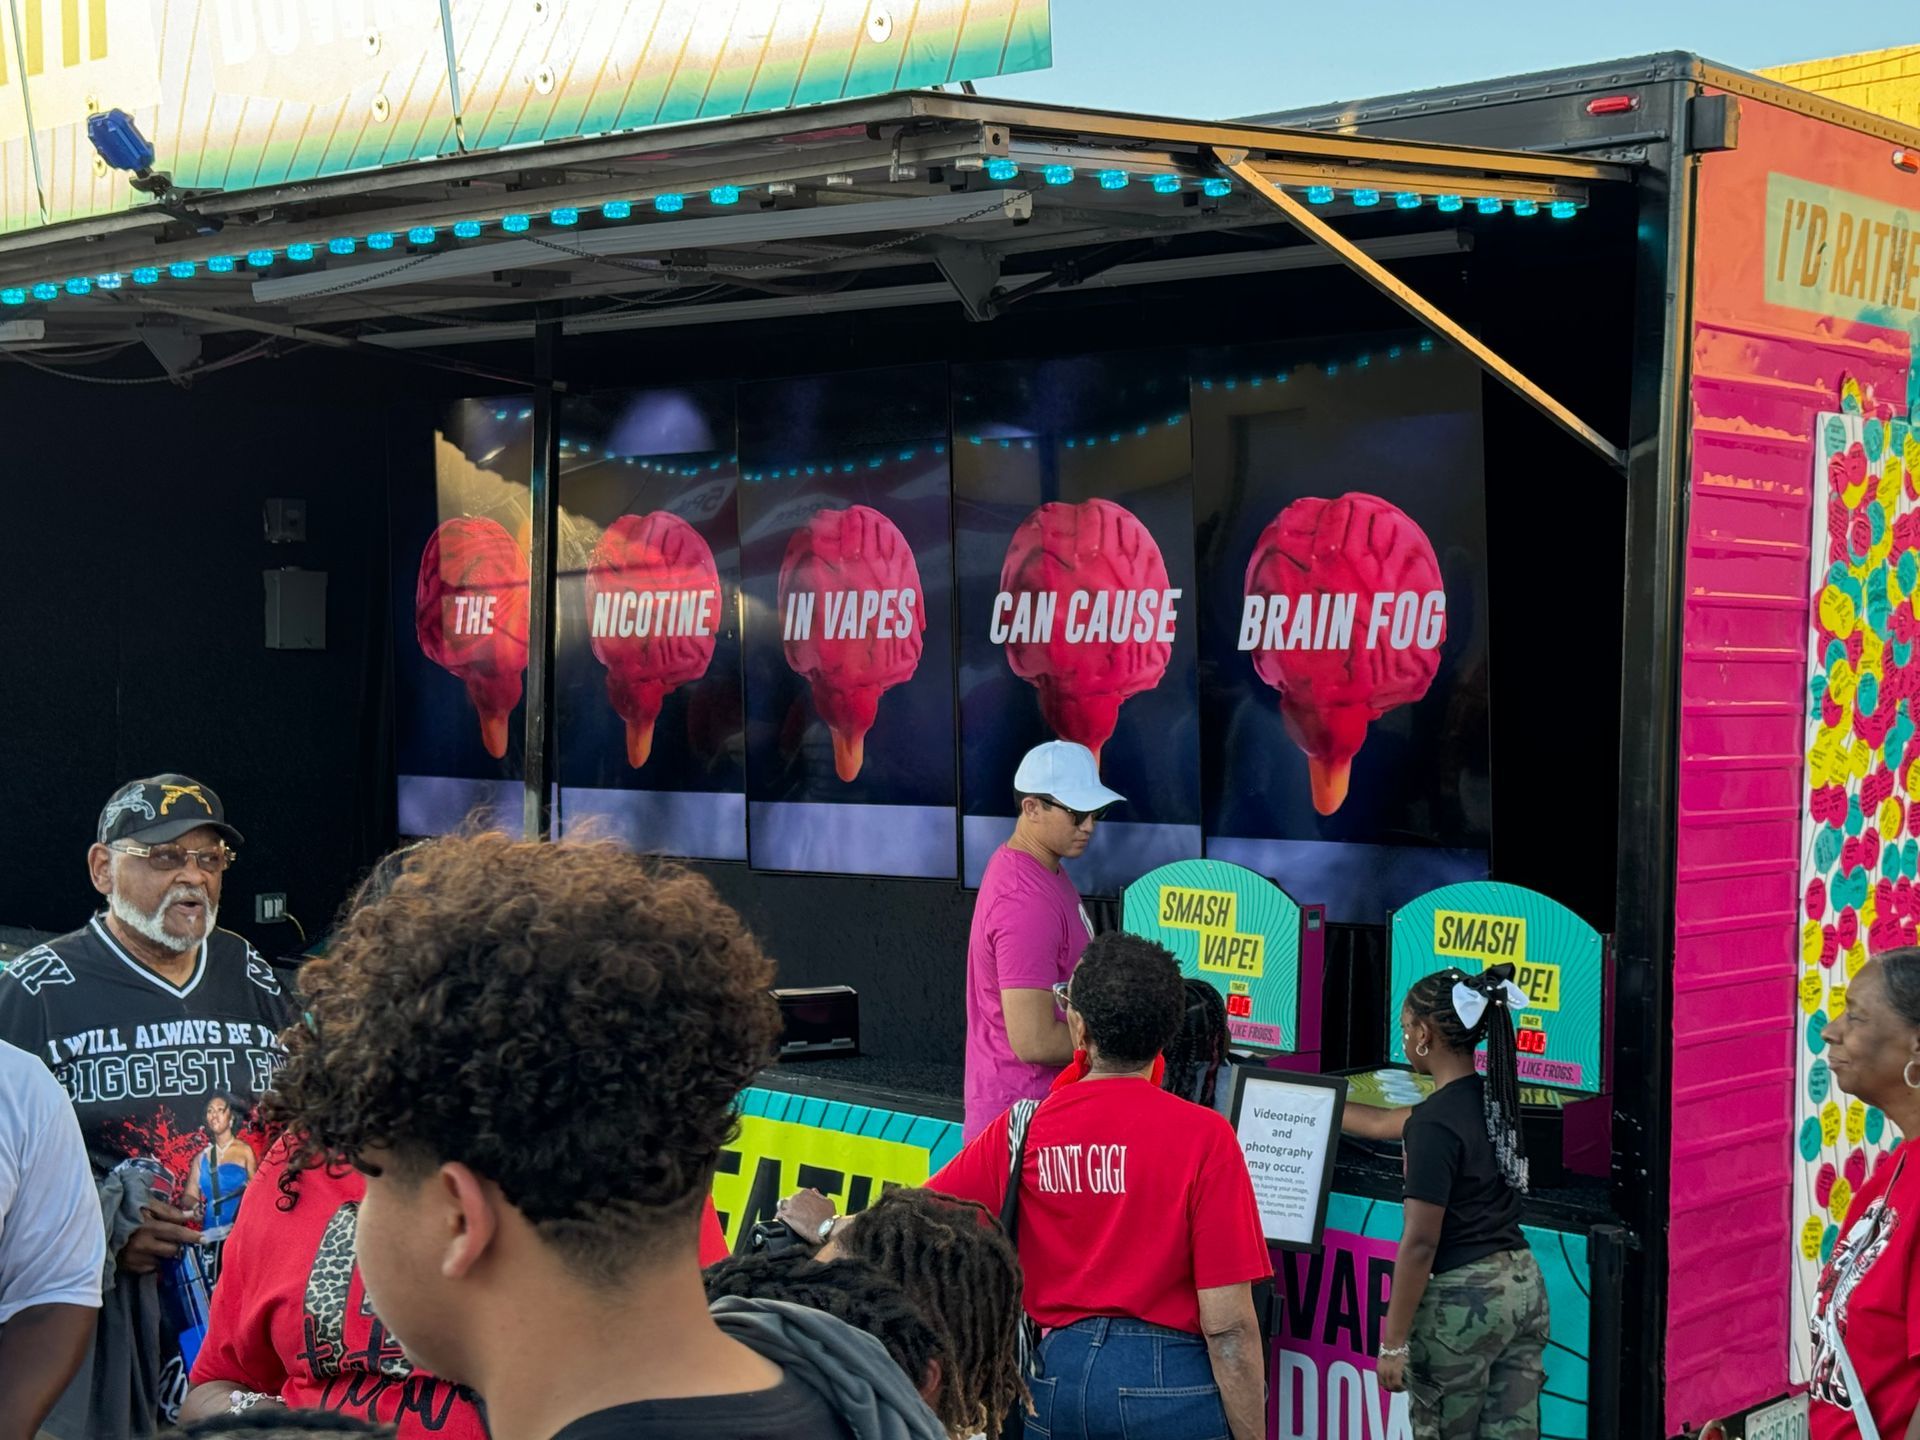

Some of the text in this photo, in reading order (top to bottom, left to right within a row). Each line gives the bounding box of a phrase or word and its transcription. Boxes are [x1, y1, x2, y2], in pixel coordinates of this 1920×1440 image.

[1777, 198, 1920, 312] I'D RATHE
[454, 595, 497, 635] THE
[591, 588, 716, 639] NICOTINE
[783, 587, 917, 641] IN VAPES
[989, 588, 1183, 645] CAN CAUSE
[1237, 590, 1447, 651] BRAIN FOG
[1163, 891, 1231, 928] SMASH
[1204, 934, 1259, 970] VAPE!
[1438, 916, 1520, 956] SMASH
[1510, 966, 1560, 1004] PE!
[1521, 1016, 1540, 1026] TIMER
[48, 1039, 62, 1064] I
[63, 1026, 127, 1057] WILL
[135, 1020, 223, 1049] ALWAYS
[224, 1022, 253, 1045] BE
[54, 1048, 235, 1103] BIGGEST
[1521, 1061, 1542, 1076] LIKE
[1543, 1063, 1574, 1081] FROGS.
[1254, 1107, 1316, 1126] Videotaping
[1272, 1128, 1292, 1139] and
[1037, 1143, 1127, 1194] AUNT GIGI
[1245, 1142, 1313, 1160] photography
[1248, 1160, 1305, 1174] may occur.
[1281, 1245, 1396, 1358] VAP
[1278, 1348, 1416, 1440] DOW
